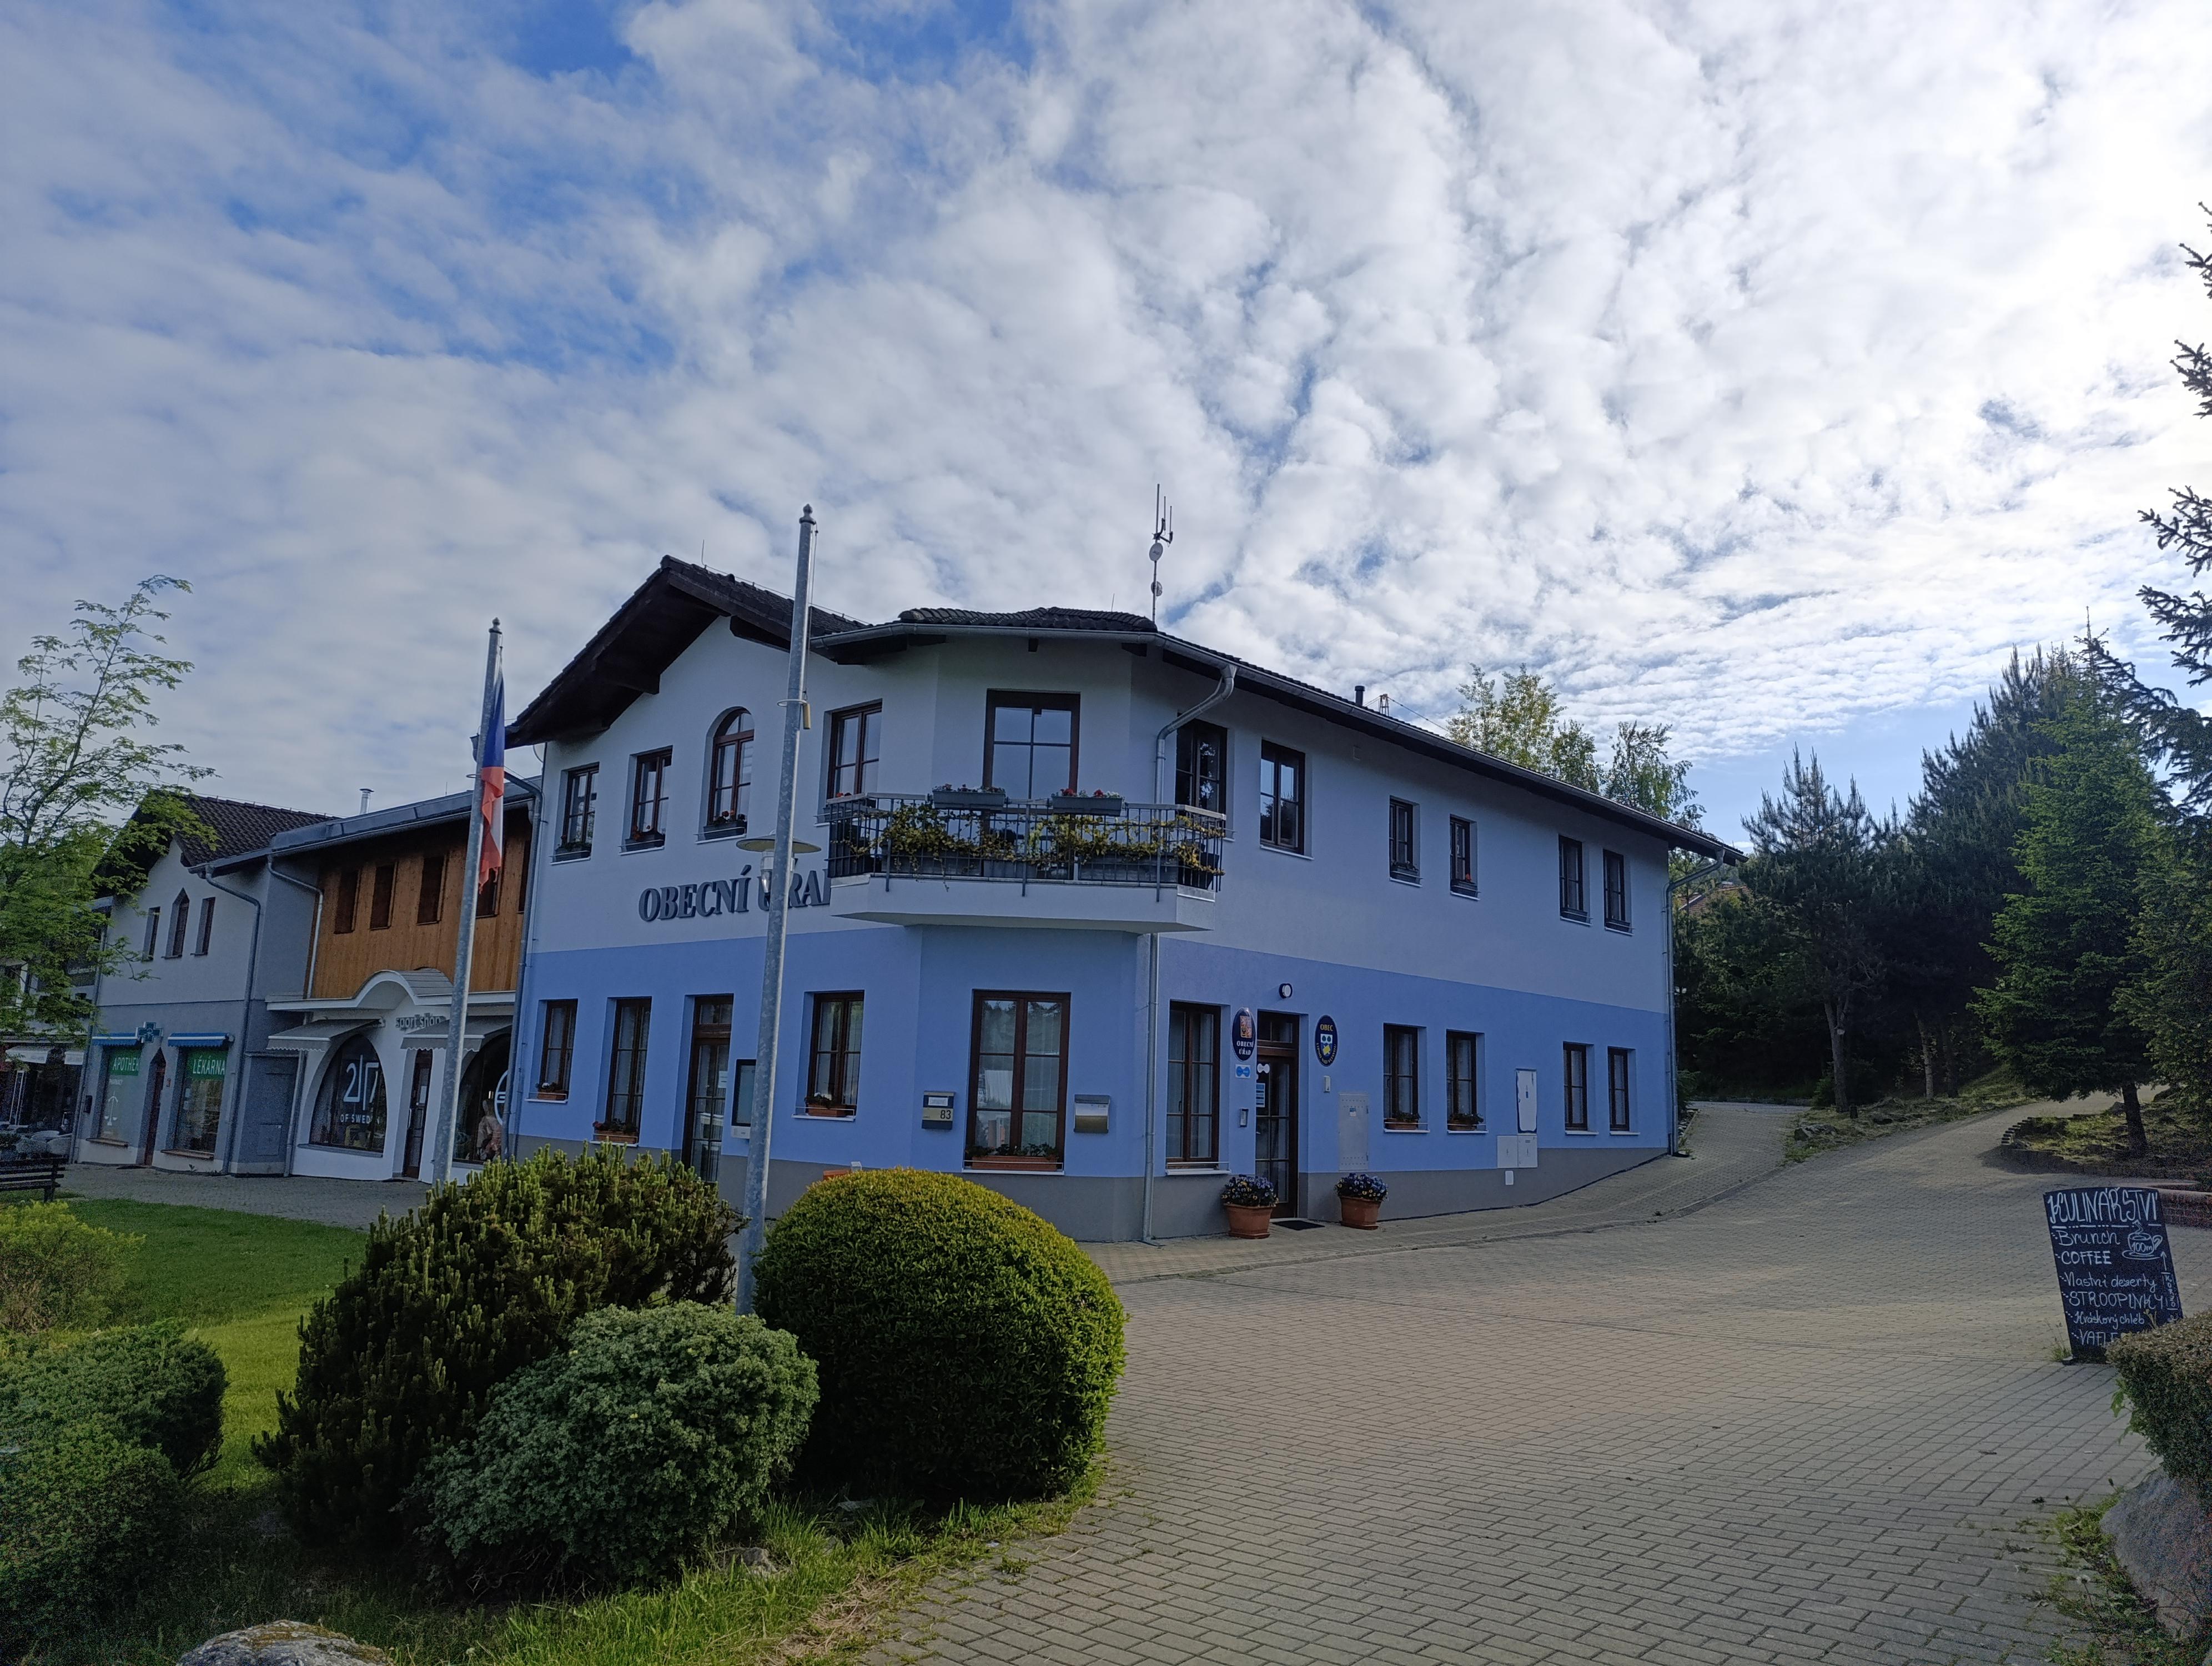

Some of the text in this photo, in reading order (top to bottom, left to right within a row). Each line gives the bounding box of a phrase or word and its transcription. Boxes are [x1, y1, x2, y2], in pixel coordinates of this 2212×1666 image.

[639, 865, 751, 922] OBECNÍ
[395, 1015, 418, 1032] sport
[192, 1055, 225, 1075] LÉKÁRNA
[340, 1114, 349, 1122] OF
[940, 1110, 951, 1120] 83
[2055, 1230, 2121, 1246] Brunch
[2132, 1242, 2153, 1253] 100m
[2061, 1251, 2112, 1265] COFFEE
[2111, 1273, 2157, 1293] dezerty
[2069, 1291, 2163, 1310] STROOPINKY
